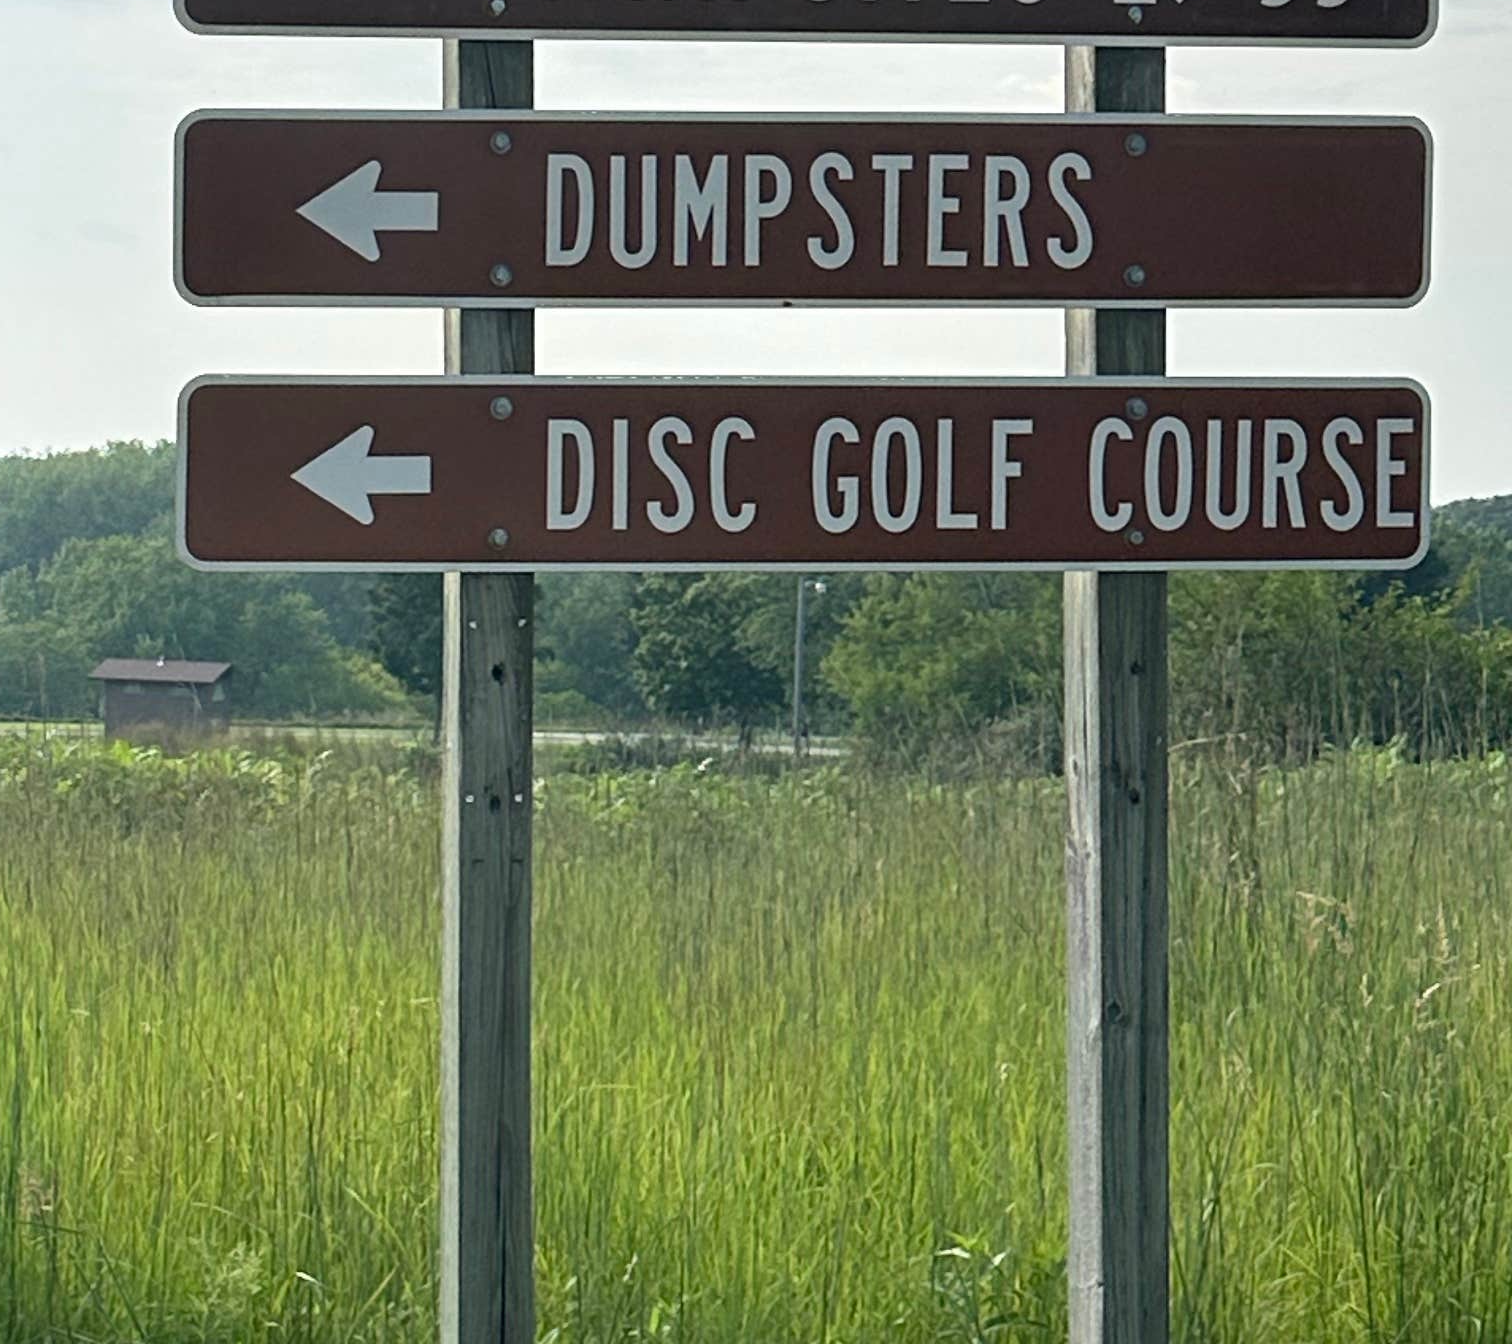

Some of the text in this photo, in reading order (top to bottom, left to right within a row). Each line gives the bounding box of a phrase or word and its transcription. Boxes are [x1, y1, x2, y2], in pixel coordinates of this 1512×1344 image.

[545, 152, 1093, 270] DUMPSTERS
[546, 416, 1415, 534] DISC GOLF COURSE
